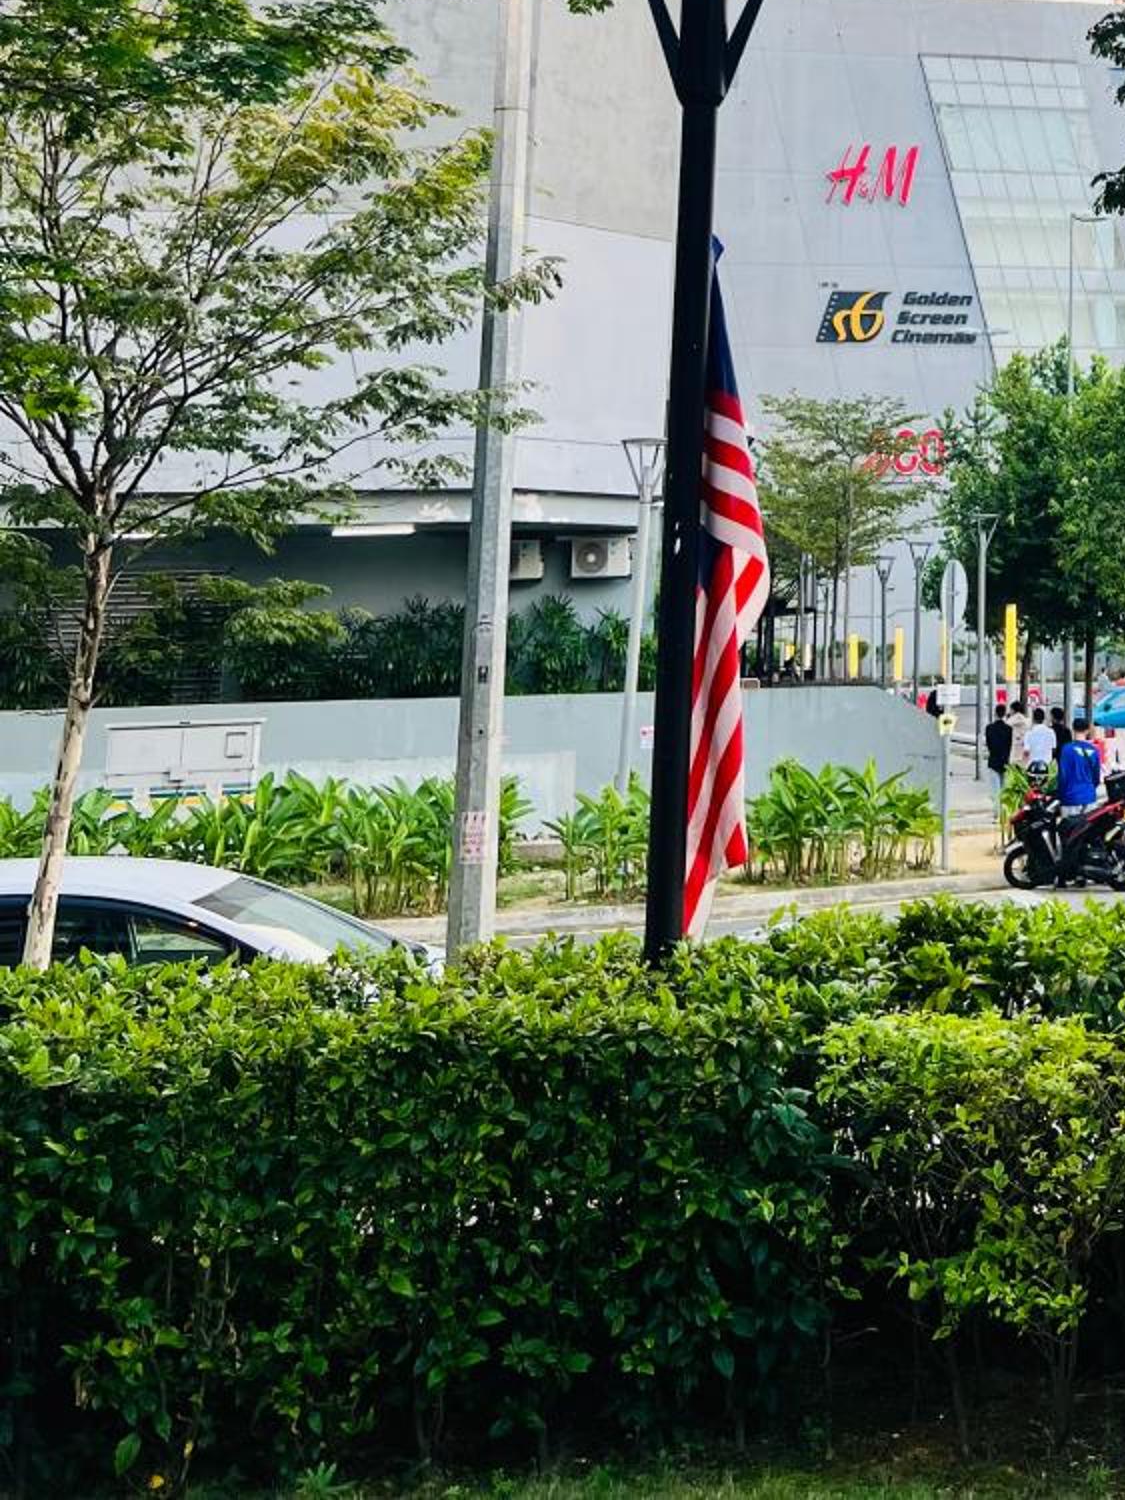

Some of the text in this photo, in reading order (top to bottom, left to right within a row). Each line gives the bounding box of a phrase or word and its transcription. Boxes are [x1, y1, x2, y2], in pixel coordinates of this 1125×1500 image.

[826, 144, 920, 207] H&M
[902, 291, 973, 306] Golden
[897, 311, 968, 326] Screen
[891, 329, 976, 345] Cinemas
